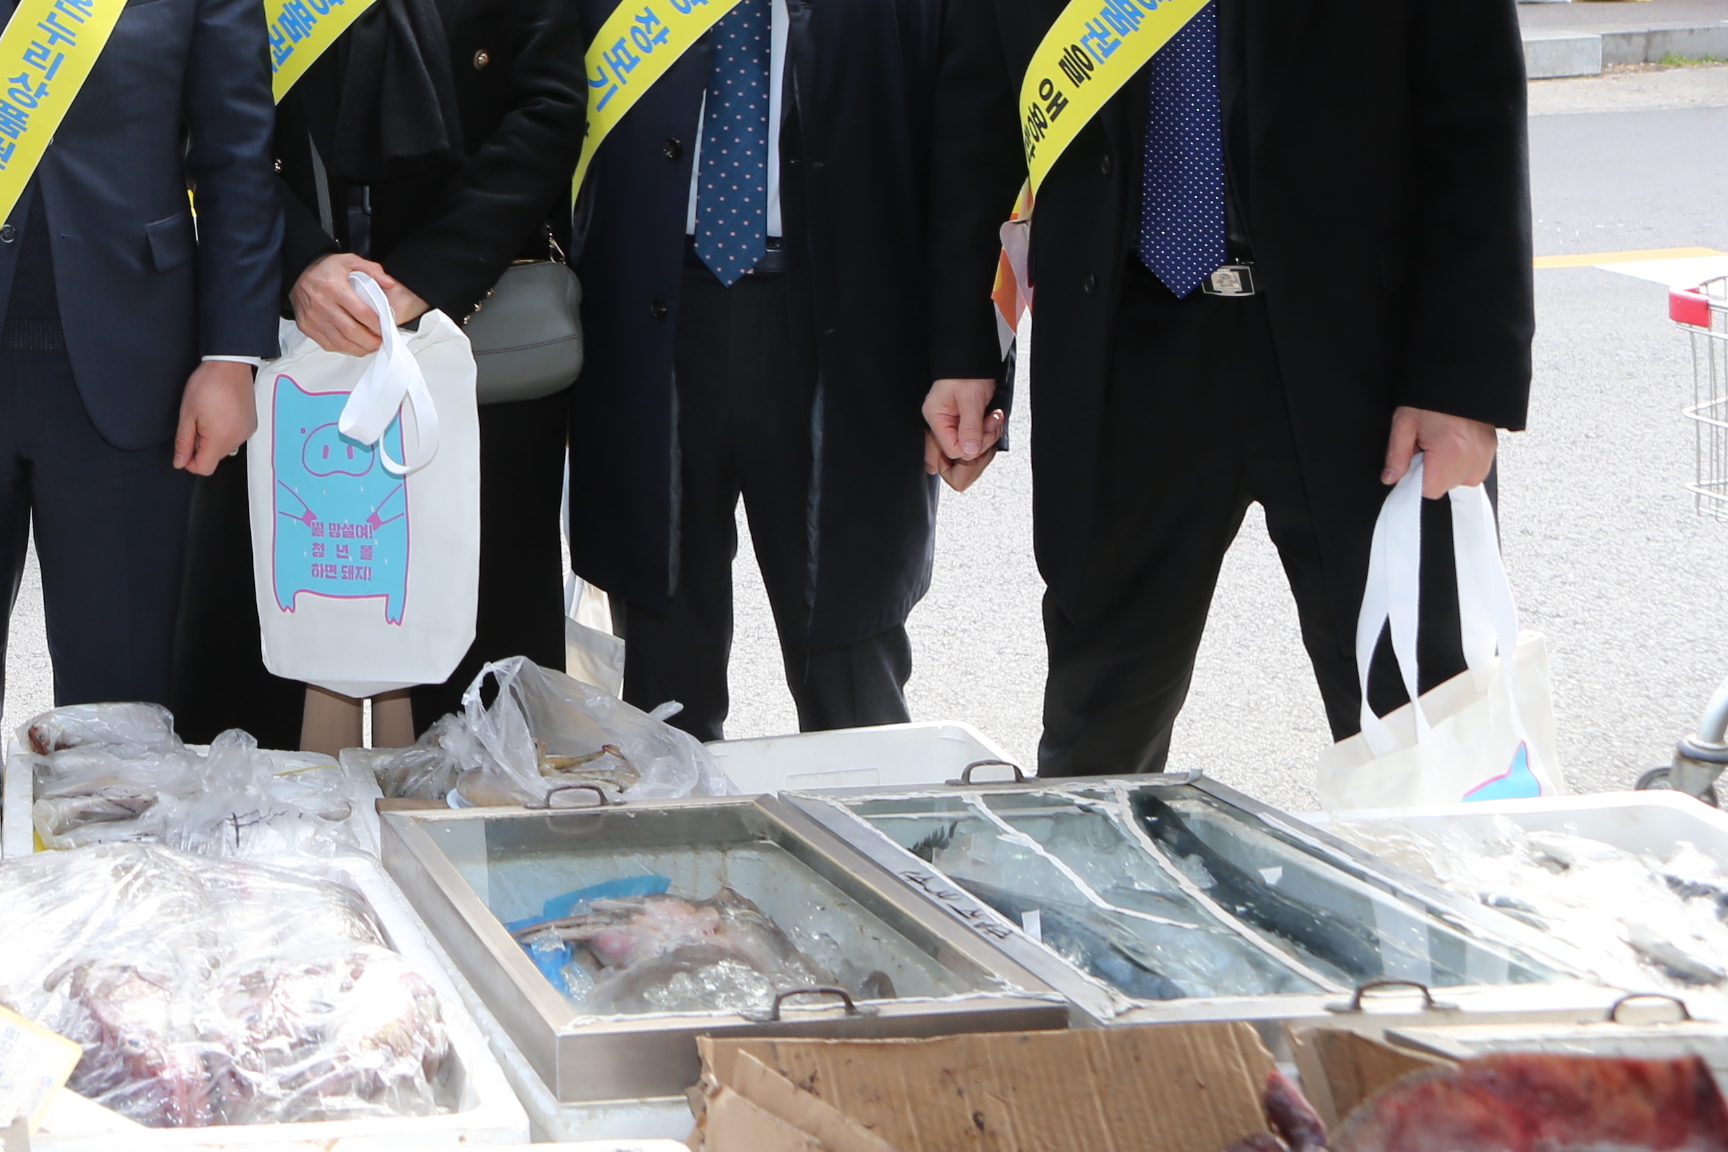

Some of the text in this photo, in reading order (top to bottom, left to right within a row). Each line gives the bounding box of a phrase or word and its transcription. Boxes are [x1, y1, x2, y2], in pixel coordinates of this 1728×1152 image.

[587, 6, 671, 112] 장보기
[328, 522, 373, 539] 망설여!
[311, 563, 372, 581] 하면 돼지!
